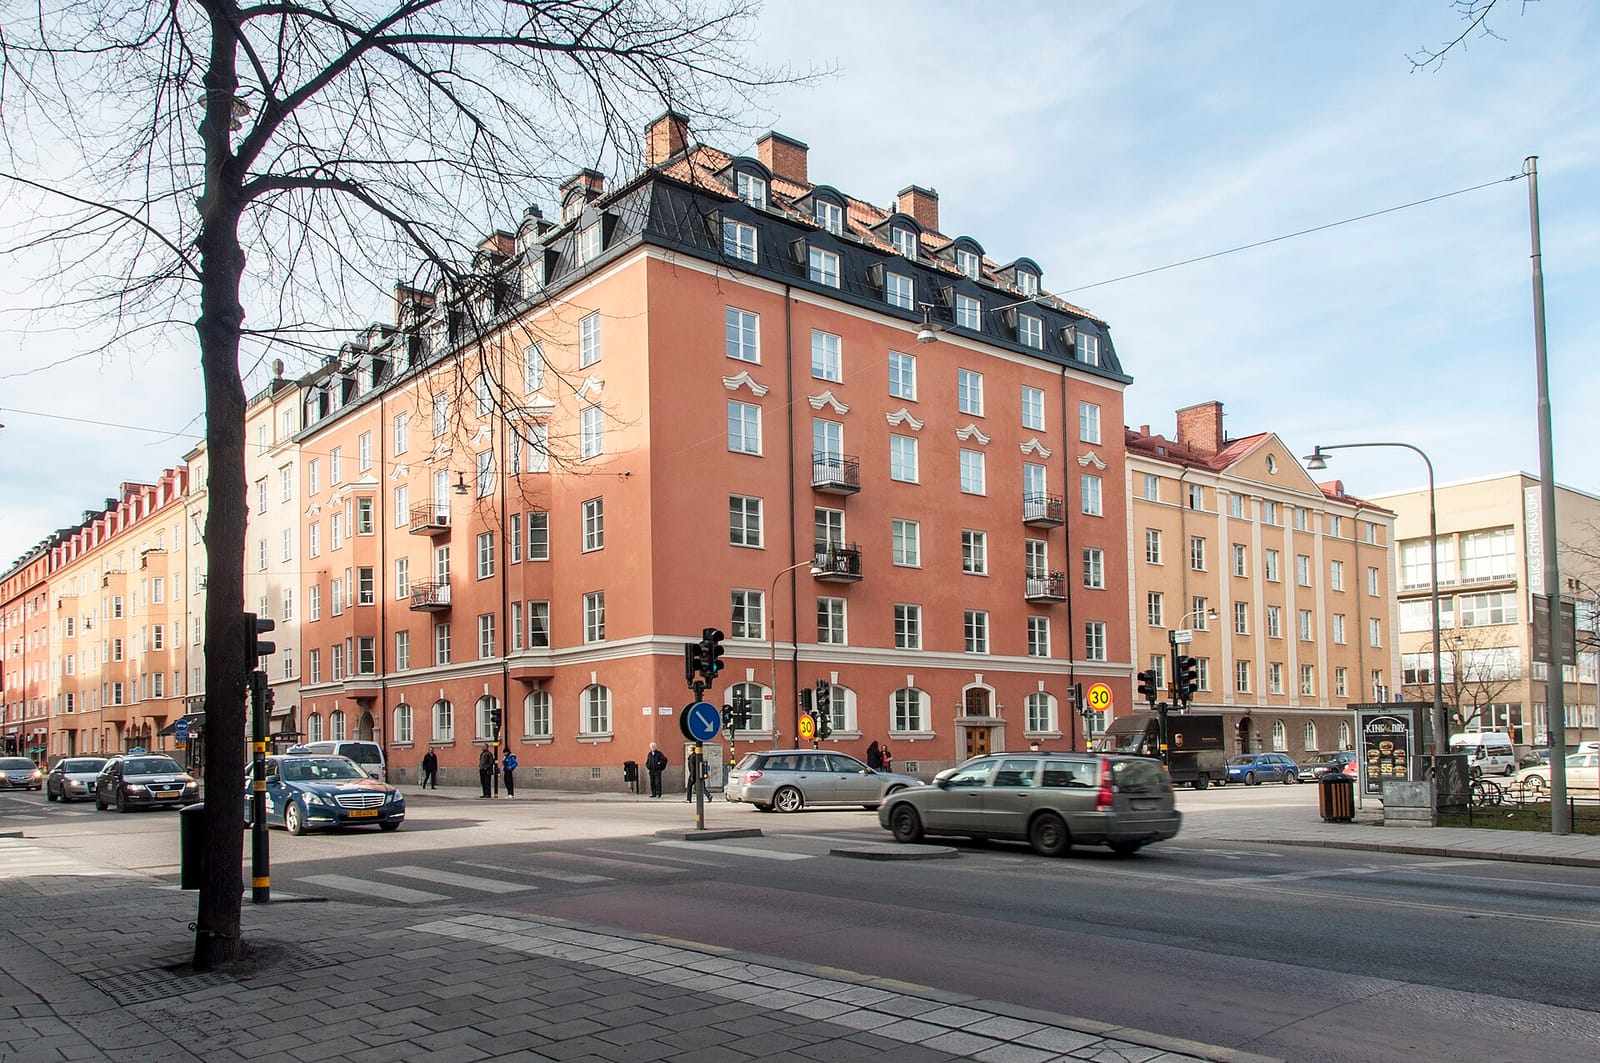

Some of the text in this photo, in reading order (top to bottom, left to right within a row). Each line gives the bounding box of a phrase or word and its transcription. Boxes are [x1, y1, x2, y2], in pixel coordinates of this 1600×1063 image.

[1528, 493, 1539, 555] GYMNASIUM
[1092, 690, 1109, 704] 30
[802, 722, 811, 733] 30
[1366, 724, 1384, 733] KING
[1392, 724, 1405, 733] DAY
[1381, 763, 1393, 772] 55
